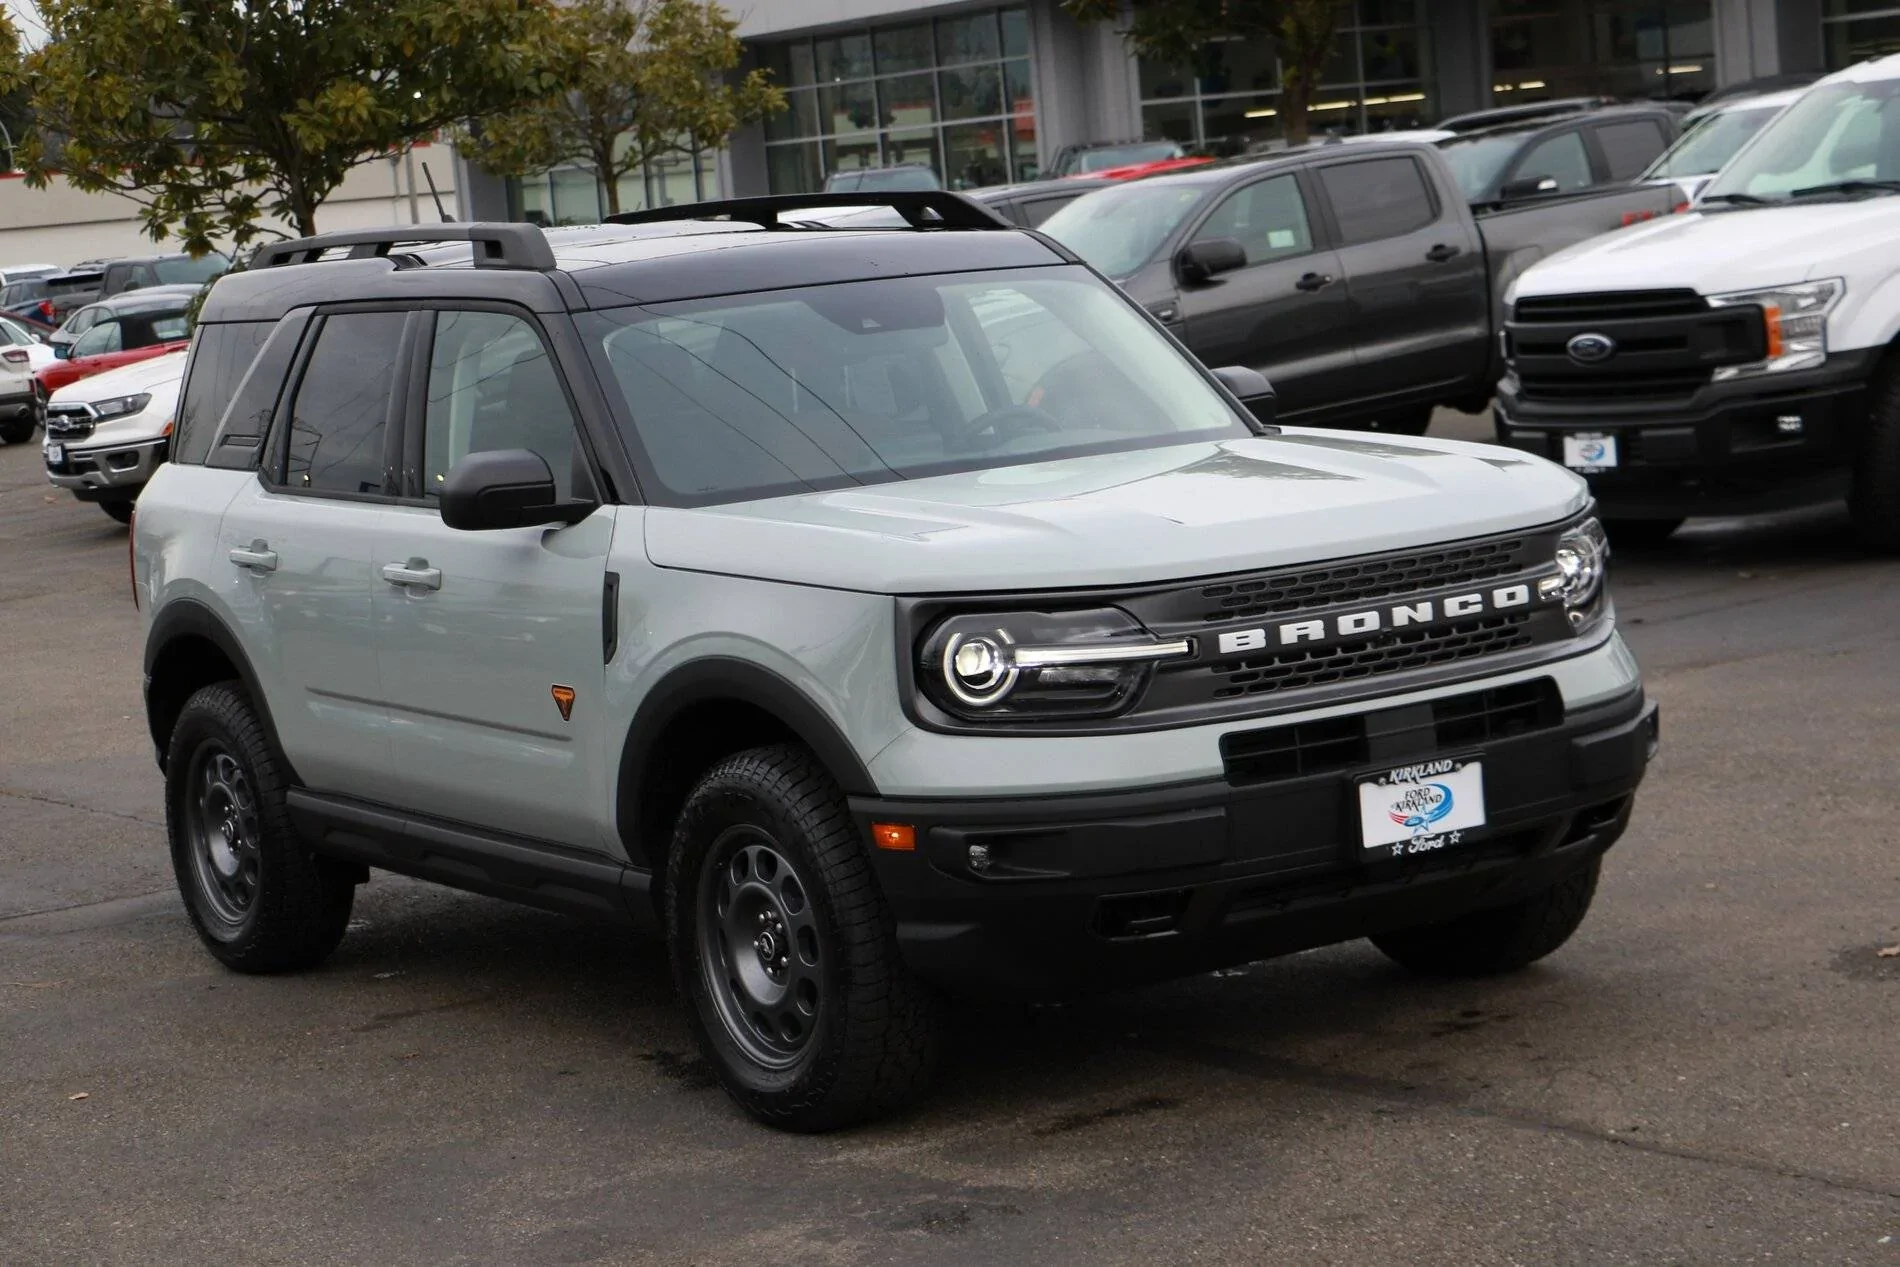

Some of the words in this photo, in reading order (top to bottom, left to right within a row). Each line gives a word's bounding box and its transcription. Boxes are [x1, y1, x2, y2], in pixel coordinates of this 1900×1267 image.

[1218, 584, 1529, 654] BRONCO
[1389, 760, 1453, 784] KIRKLAND
[1395, 794, 1442, 812] KIRKLAND
[1405, 787, 1431, 801] FORD
[1408, 833, 1445, 853] Ford
